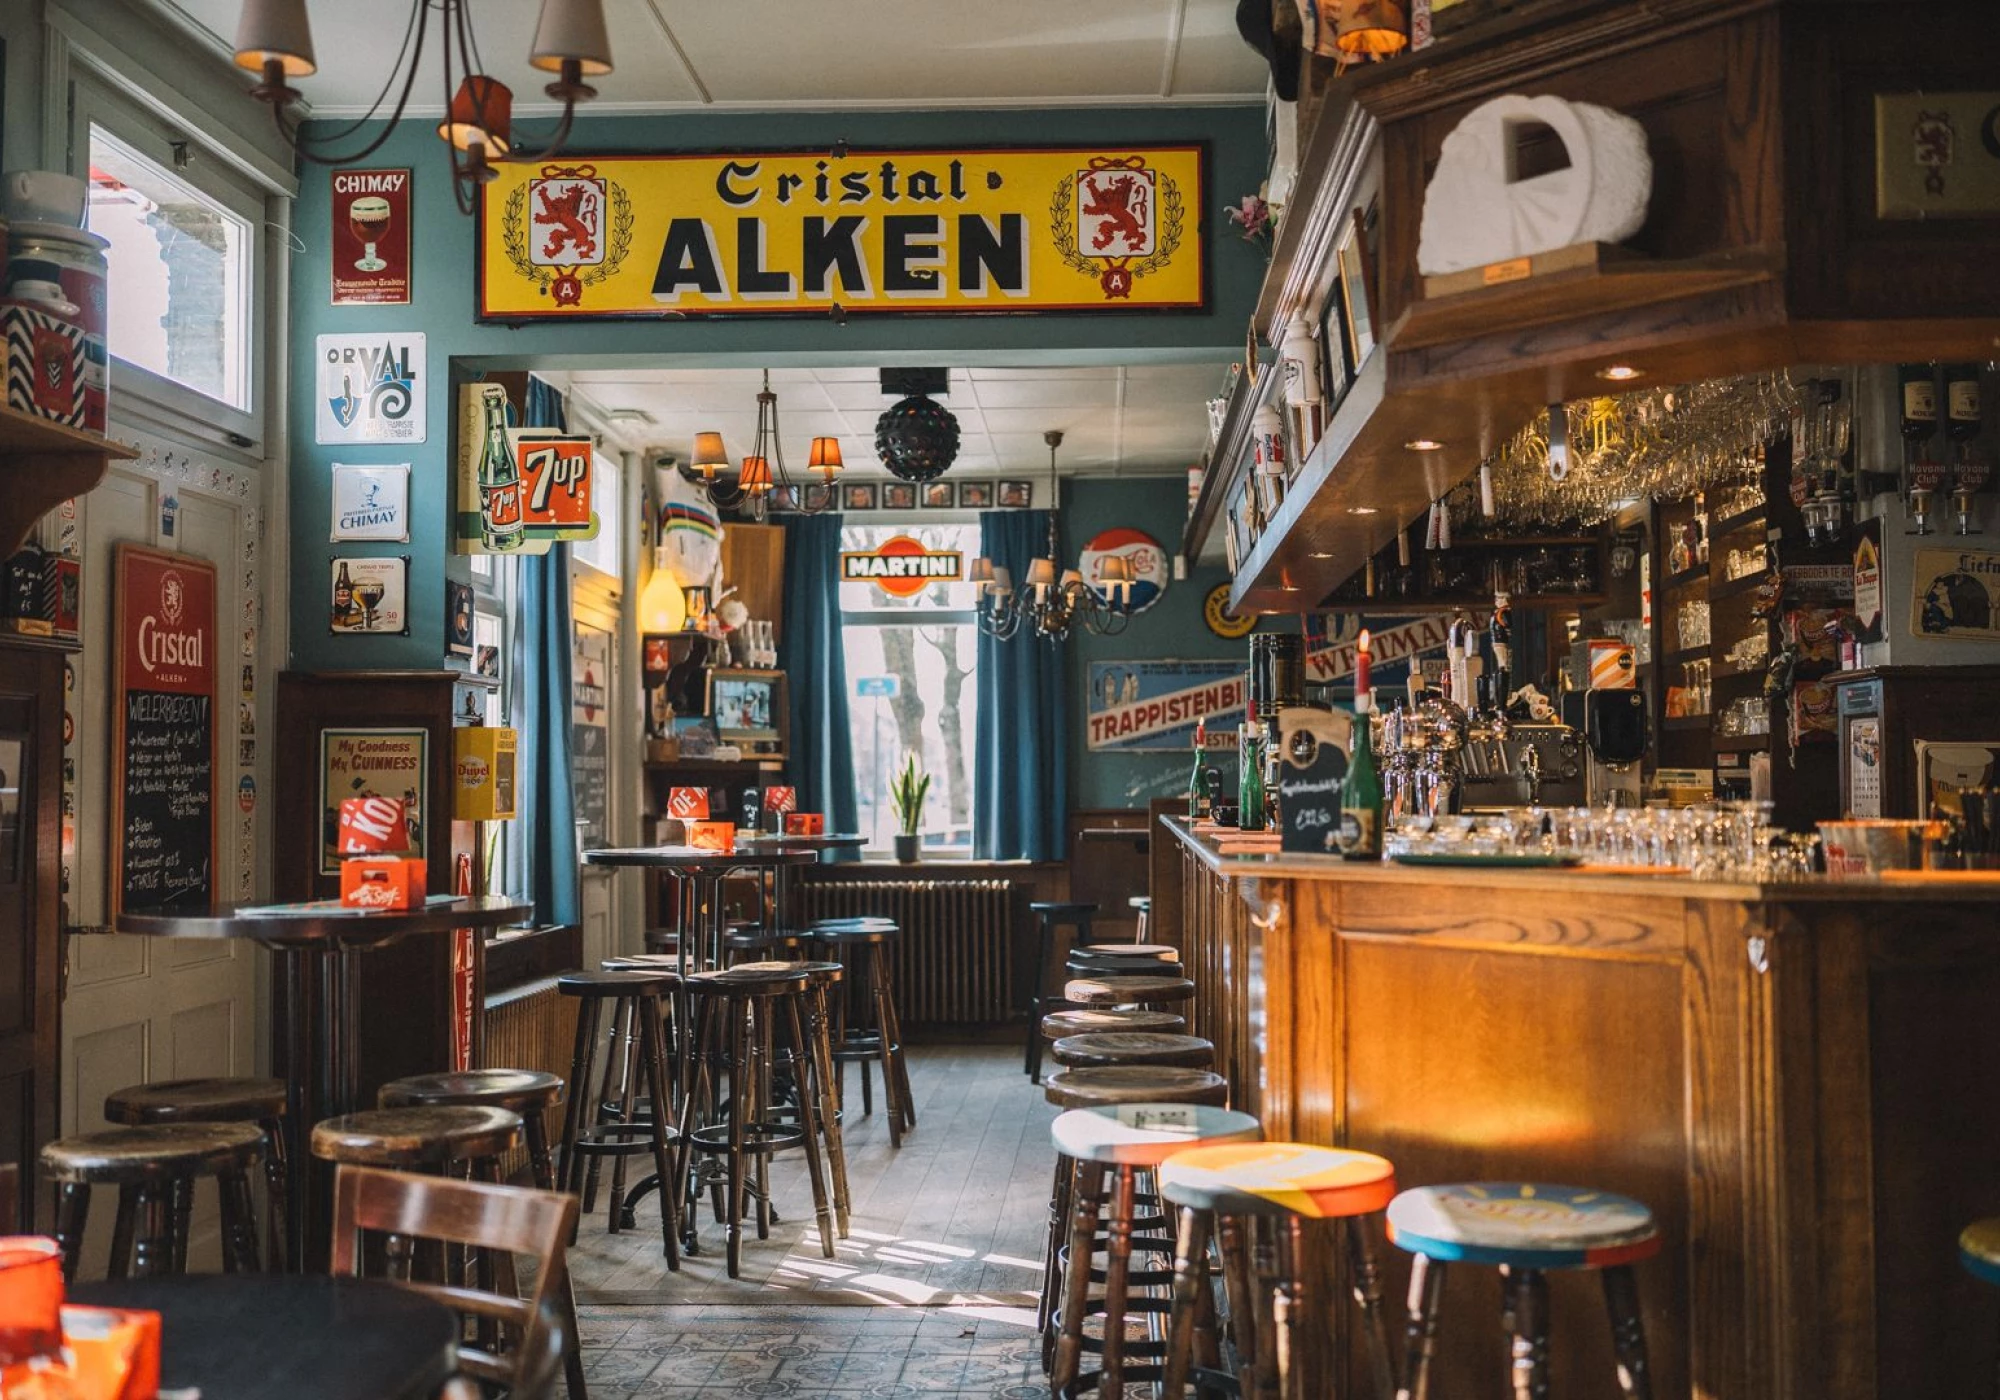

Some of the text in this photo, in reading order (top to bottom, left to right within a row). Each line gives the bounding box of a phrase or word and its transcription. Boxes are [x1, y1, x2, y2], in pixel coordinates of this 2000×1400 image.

[334, 174, 405, 194] CHIMAY
[715, 158, 968, 206] Cristal
[651, 213, 1030, 300] ALKEN
[326, 340, 416, 388] ORVAL
[1917, 473, 1938, 484] Club
[1961, 473, 1982, 484] Club
[340, 511, 397, 530] CHIMAY
[847, 556, 957, 577] MARTINI
[139, 615, 203, 672] Cristal
[160, 673, 183, 683] ALKEN
[339, 740, 411, 754] My Goodness
[1194, 733, 1238, 748] ESTM
[331, 755, 417, 773] My GUINNESS
[458, 764, 490, 776] Duvel
